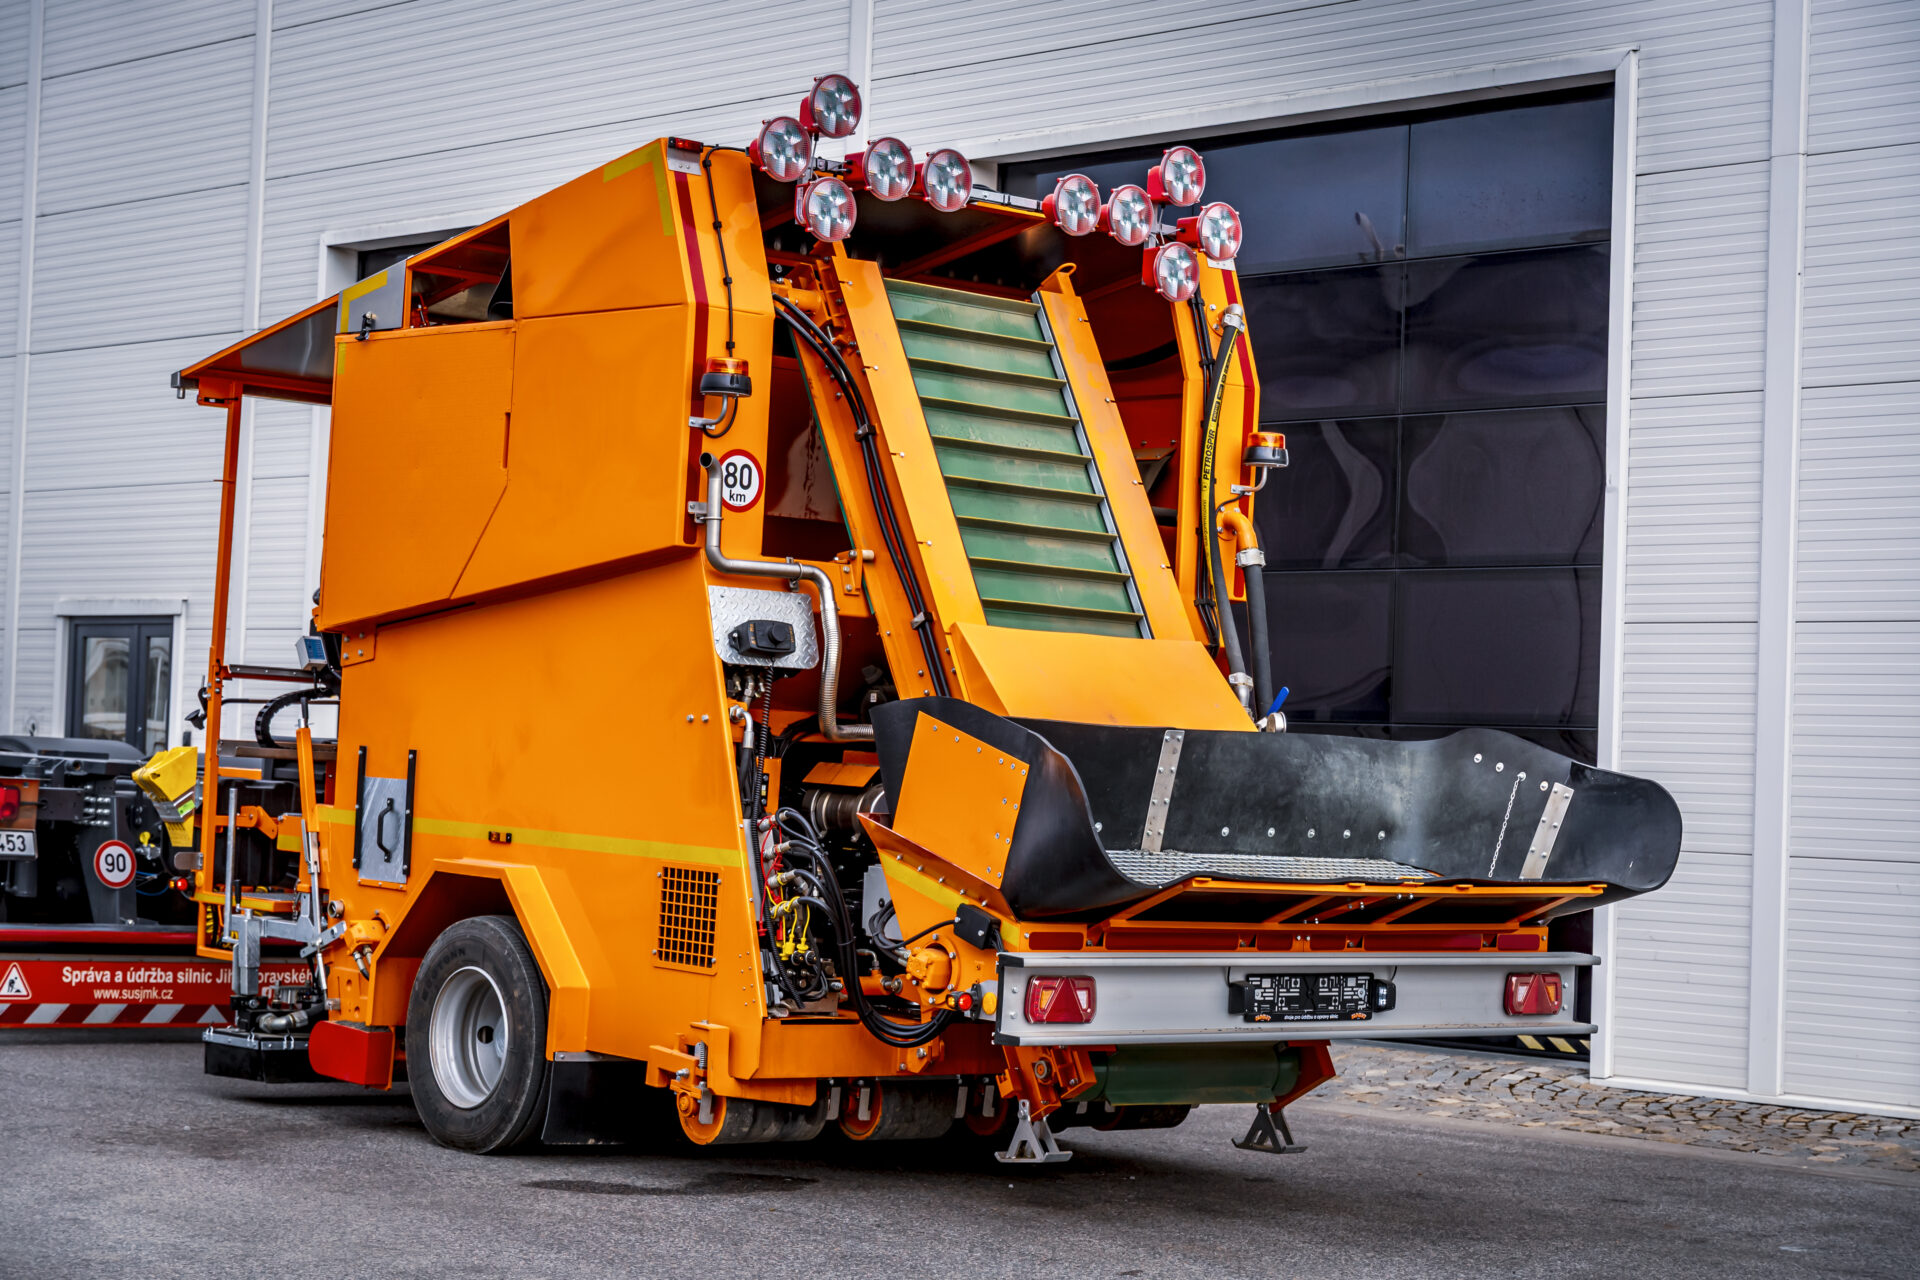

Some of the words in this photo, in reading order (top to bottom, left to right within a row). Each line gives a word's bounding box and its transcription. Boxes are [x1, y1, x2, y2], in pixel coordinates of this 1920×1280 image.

[1203, 429, 1215, 480] PETROSPIR
[724, 462, 752, 490] 80
[729, 489, 746, 502] km
[105, 853, 126, 872] 90
[62, 967, 111, 986] Správa
[114, 971, 123, 983] a
[127, 967, 173, 983] údržba
[177, 968, 213, 984] silnic
[93, 987, 174, 1003] www.susjmk.cz
